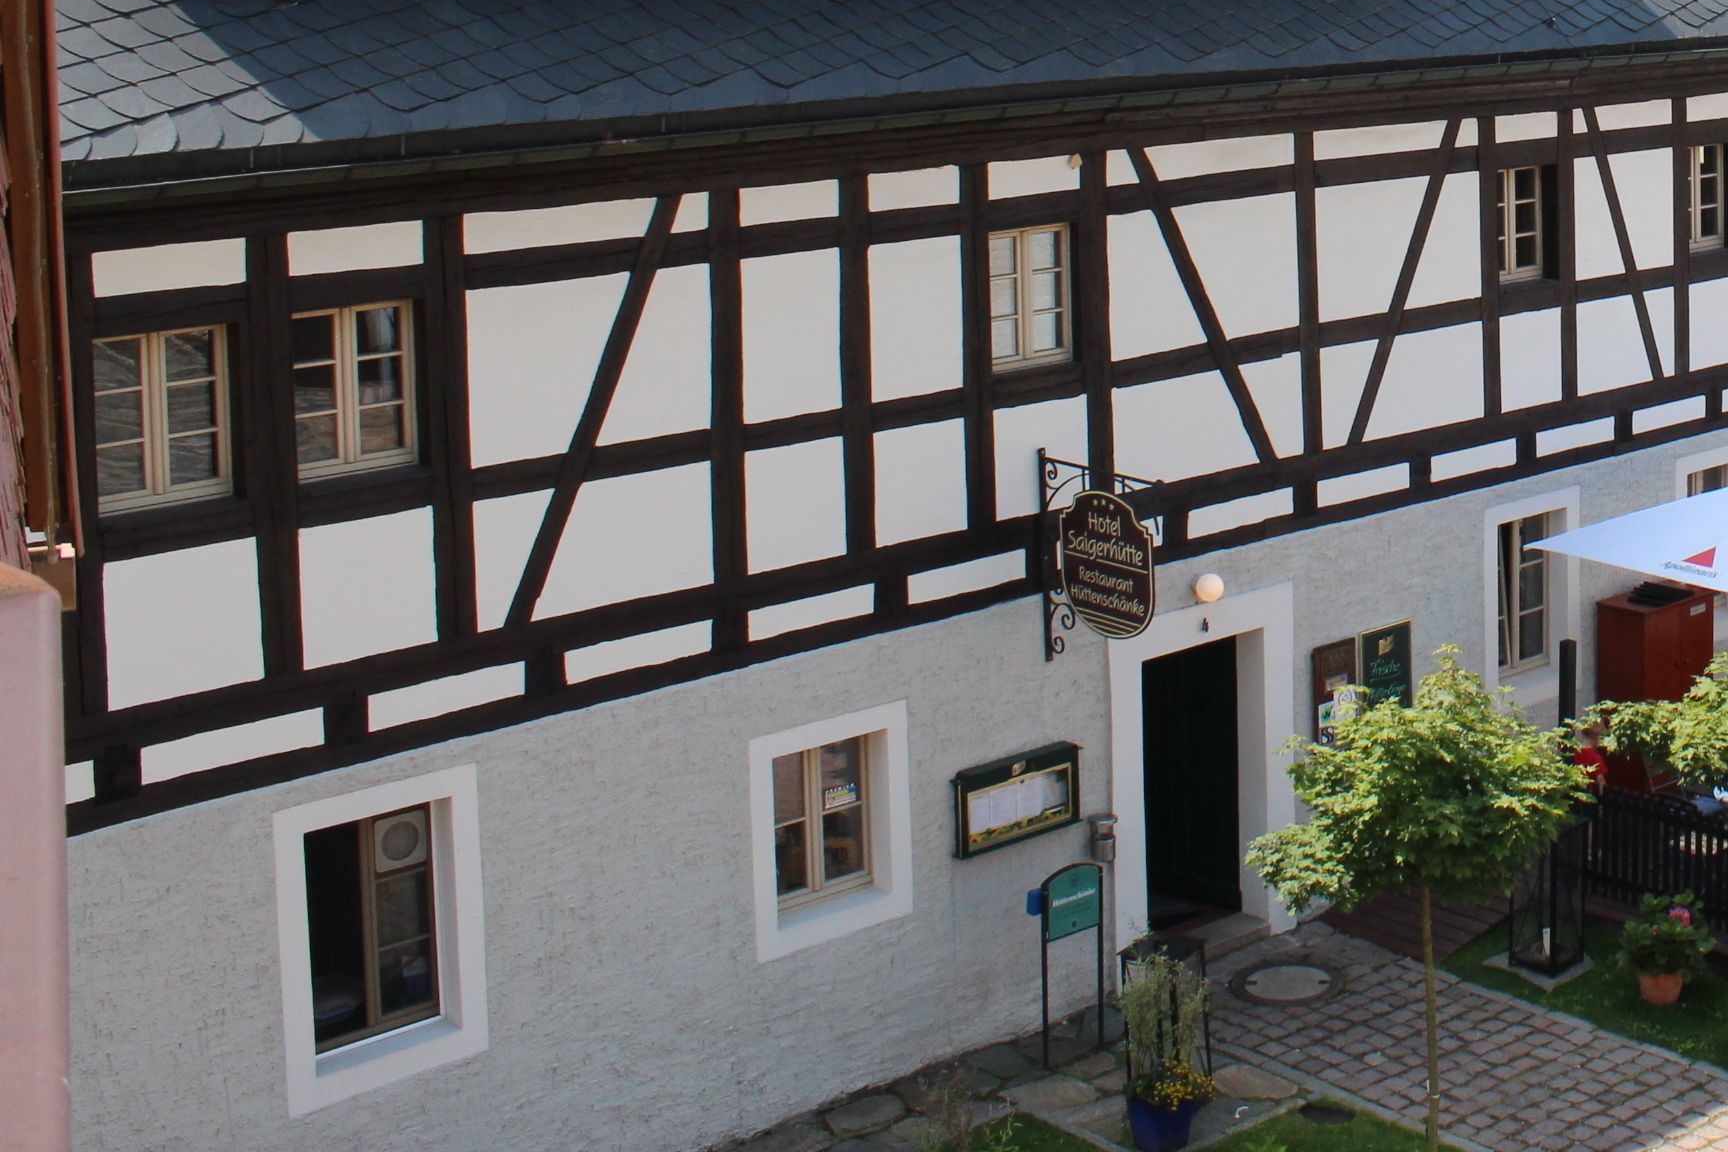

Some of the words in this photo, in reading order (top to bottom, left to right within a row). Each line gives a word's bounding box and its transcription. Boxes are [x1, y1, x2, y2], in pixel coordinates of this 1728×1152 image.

[1087, 511, 1121, 537] Hotel
[1068, 530, 1143, 566] Saigerhütte
[1079, 566, 1133, 593] Restaurant
[1070, 583, 1145, 617] Hüttenschänke
